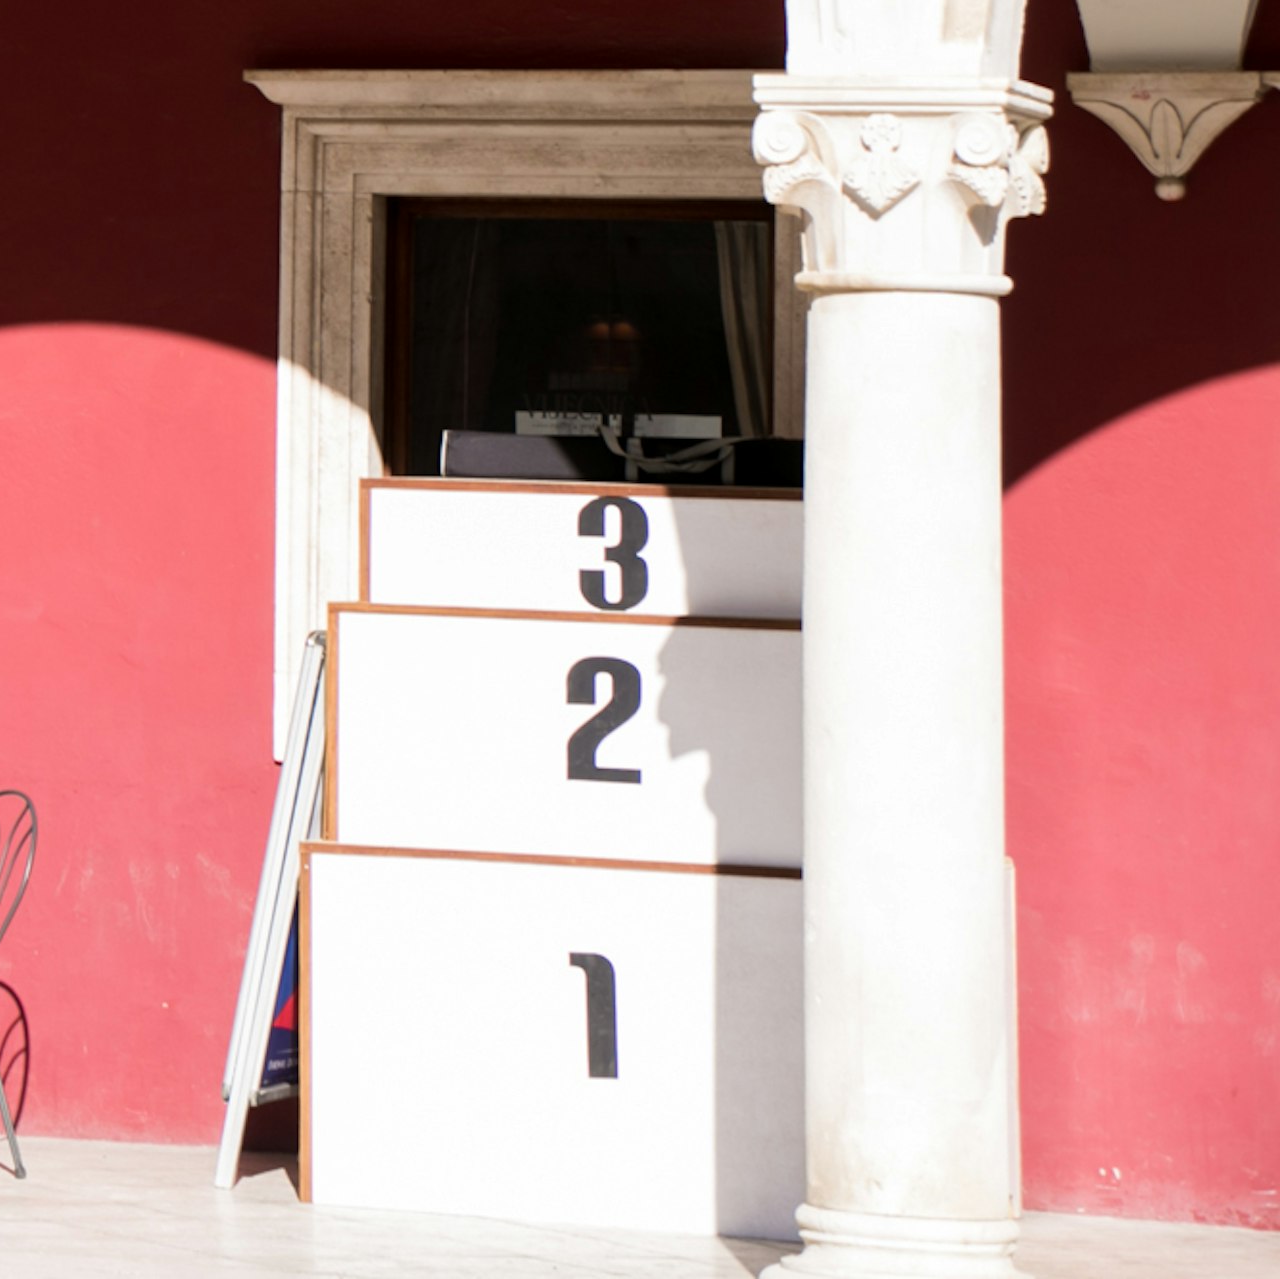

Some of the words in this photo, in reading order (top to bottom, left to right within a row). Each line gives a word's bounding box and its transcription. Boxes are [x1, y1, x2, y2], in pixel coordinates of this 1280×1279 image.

[578, 495, 649, 611] 3
[566, 656, 642, 783] 2
[569, 951, 618, 1079] 1
